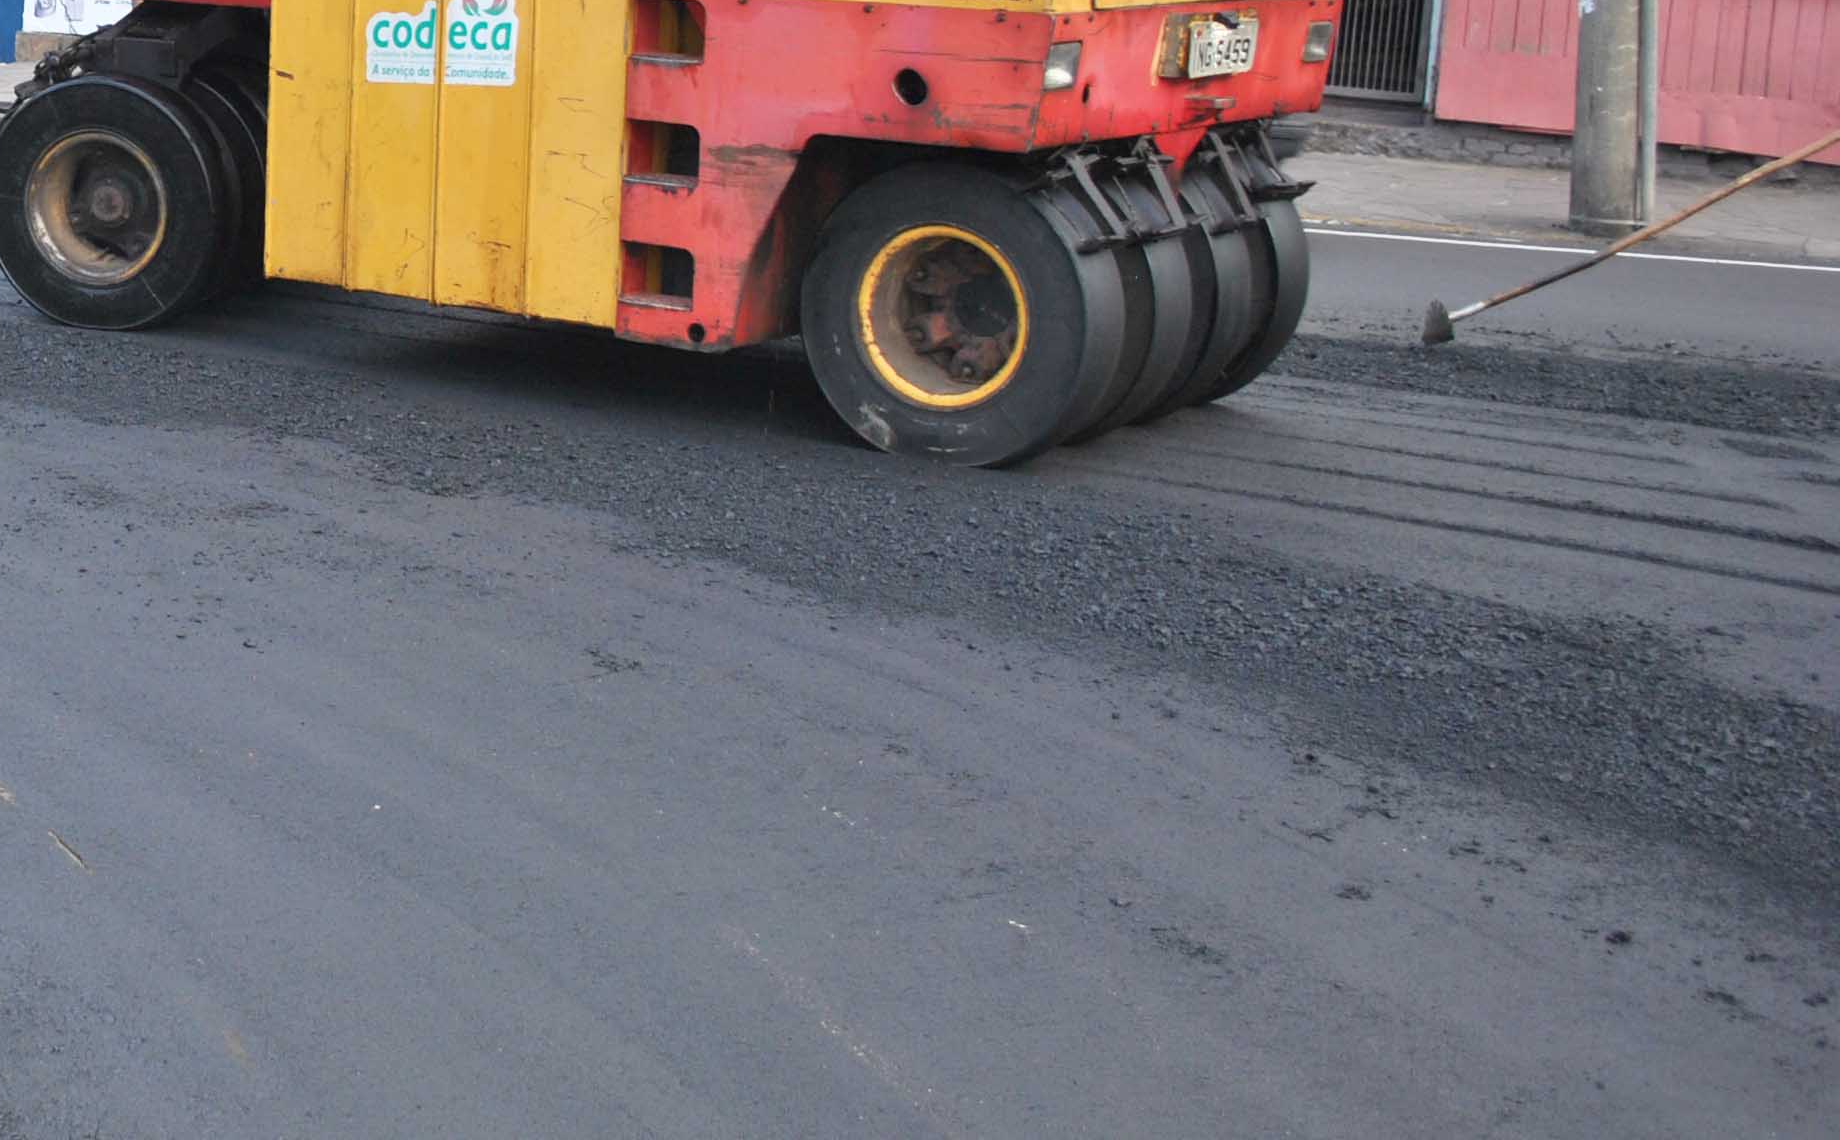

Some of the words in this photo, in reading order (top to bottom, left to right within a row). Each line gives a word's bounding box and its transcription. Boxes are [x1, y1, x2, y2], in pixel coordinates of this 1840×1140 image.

[373, 8, 512, 50] codeca
[372, 64, 379, 74] A
[382, 65, 412, 79] serviço
[417, 66, 430, 77] da
